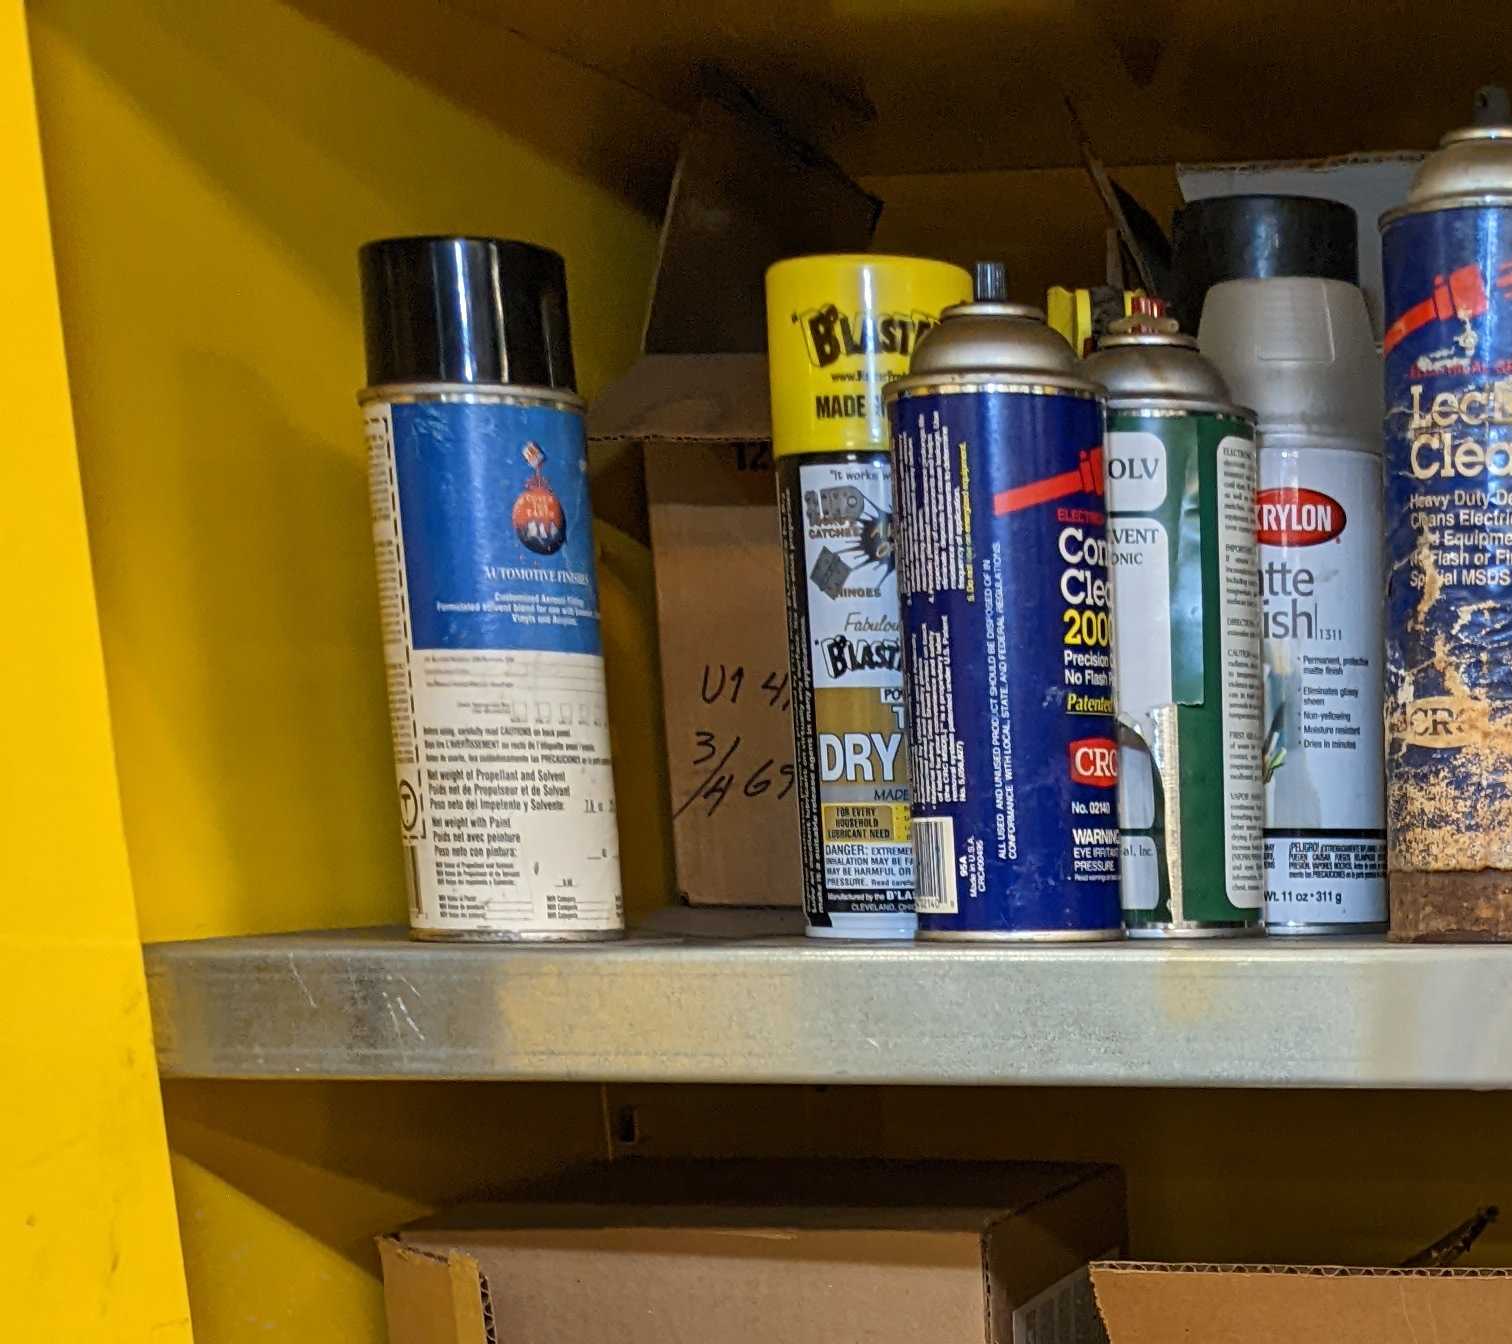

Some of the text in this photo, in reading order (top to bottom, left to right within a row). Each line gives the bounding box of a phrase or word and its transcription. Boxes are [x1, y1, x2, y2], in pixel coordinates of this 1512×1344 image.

[816, 394, 864, 418] MADE
[1108, 458, 1159, 480] OLV
[1410, 493, 1450, 510] Heavy
[1454, 490, 1489, 509] Duty
[1111, 528, 1159, 545] VENT
[1462, 569, 1511, 586] MSDS
[1319, 629, 1343, 641] 1311
[1064, 650, 1109, 668] Precision
[1065, 669, 1082, 685] No
[819, 733, 902, 782] DRY
[1075, 748, 1118, 777] CRC
[874, 789, 909, 800] MADE
[869, 829, 890, 839] NEED
[1282, 890, 1333, 902] 11 oz 311
